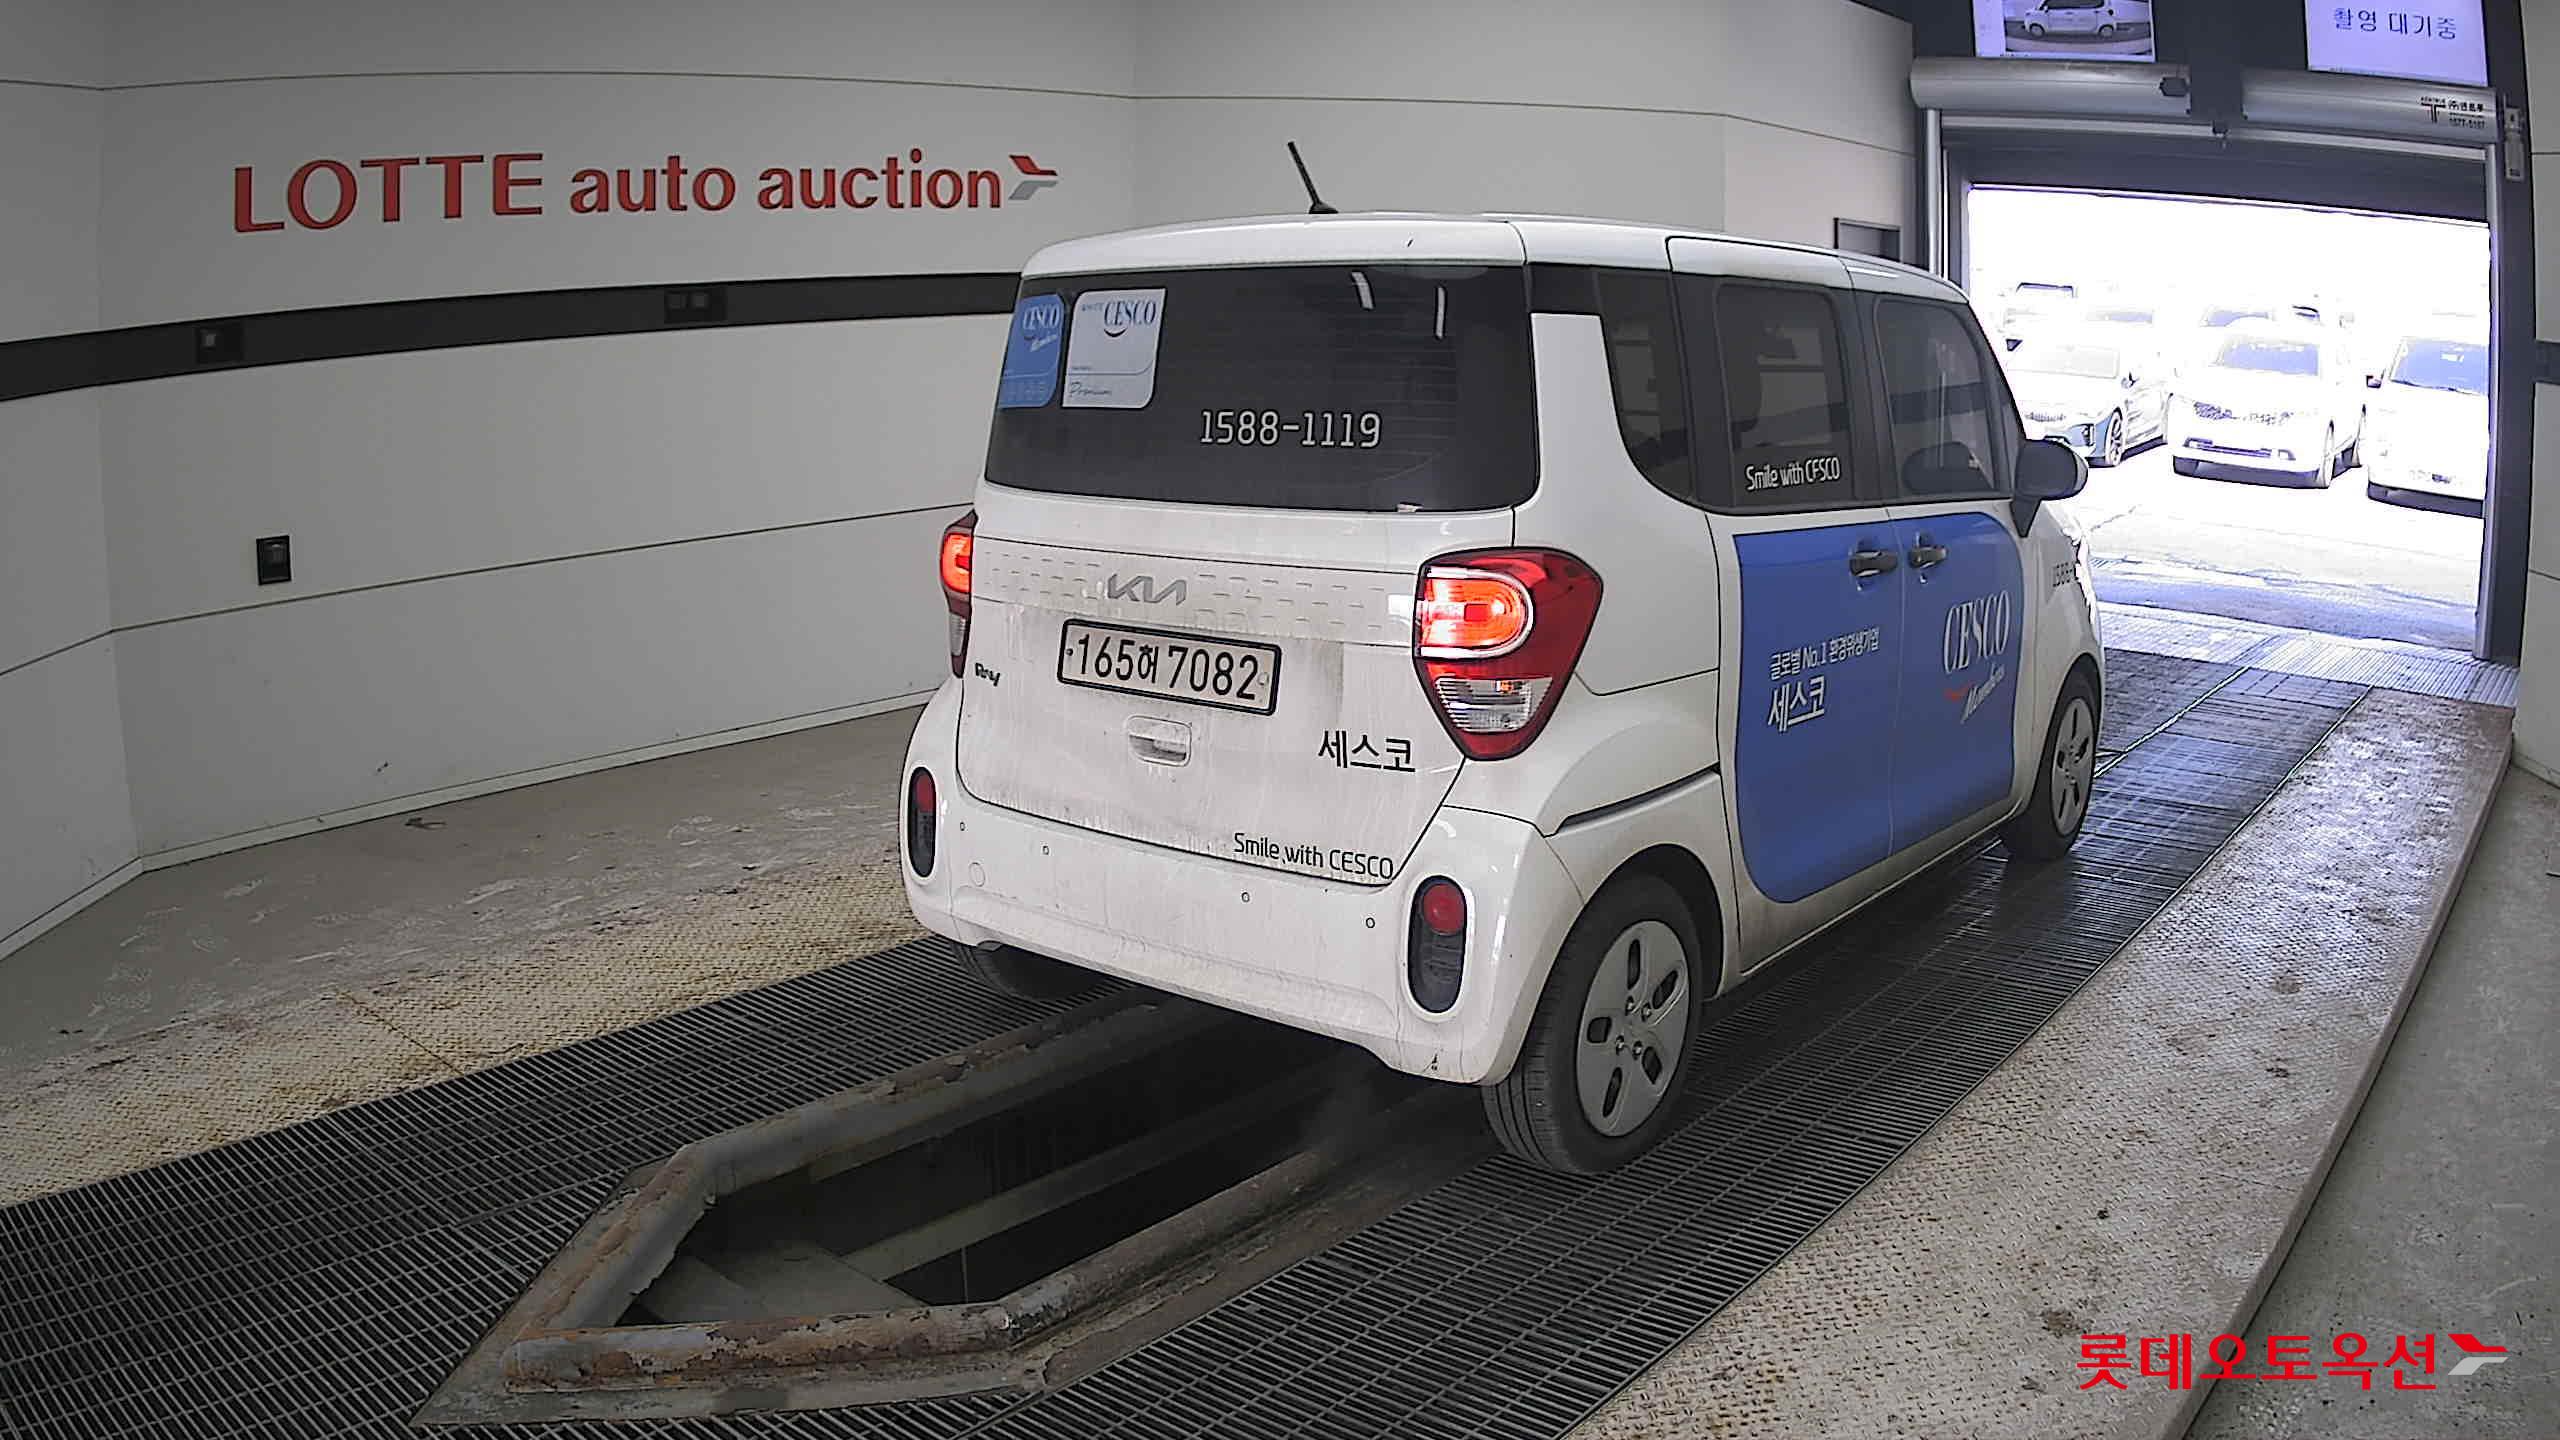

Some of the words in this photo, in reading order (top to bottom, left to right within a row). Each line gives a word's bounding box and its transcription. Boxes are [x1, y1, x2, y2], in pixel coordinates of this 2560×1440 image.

[2388, 12, 2457, 40] 대기중
[234, 152, 544, 233] LOTTE
[569, 155, 736, 215] auto
[756, 147, 1002, 211] auction
[1104, 300, 1156, 327] CESCO
[1199, 410, 1382, 449] 1588-1119
[1745, 464, 1779, 491] Smile
[1779, 460, 1805, 486] with
[1944, 590, 2010, 674] CESCO
[1768, 675, 1825, 733] 세스코
[1318, 730, 1416, 773] 세스코
[1234, 832, 1280, 860] Smile
[1284, 845, 1324, 868] with
[1329, 849, 1394, 880] CESCO
